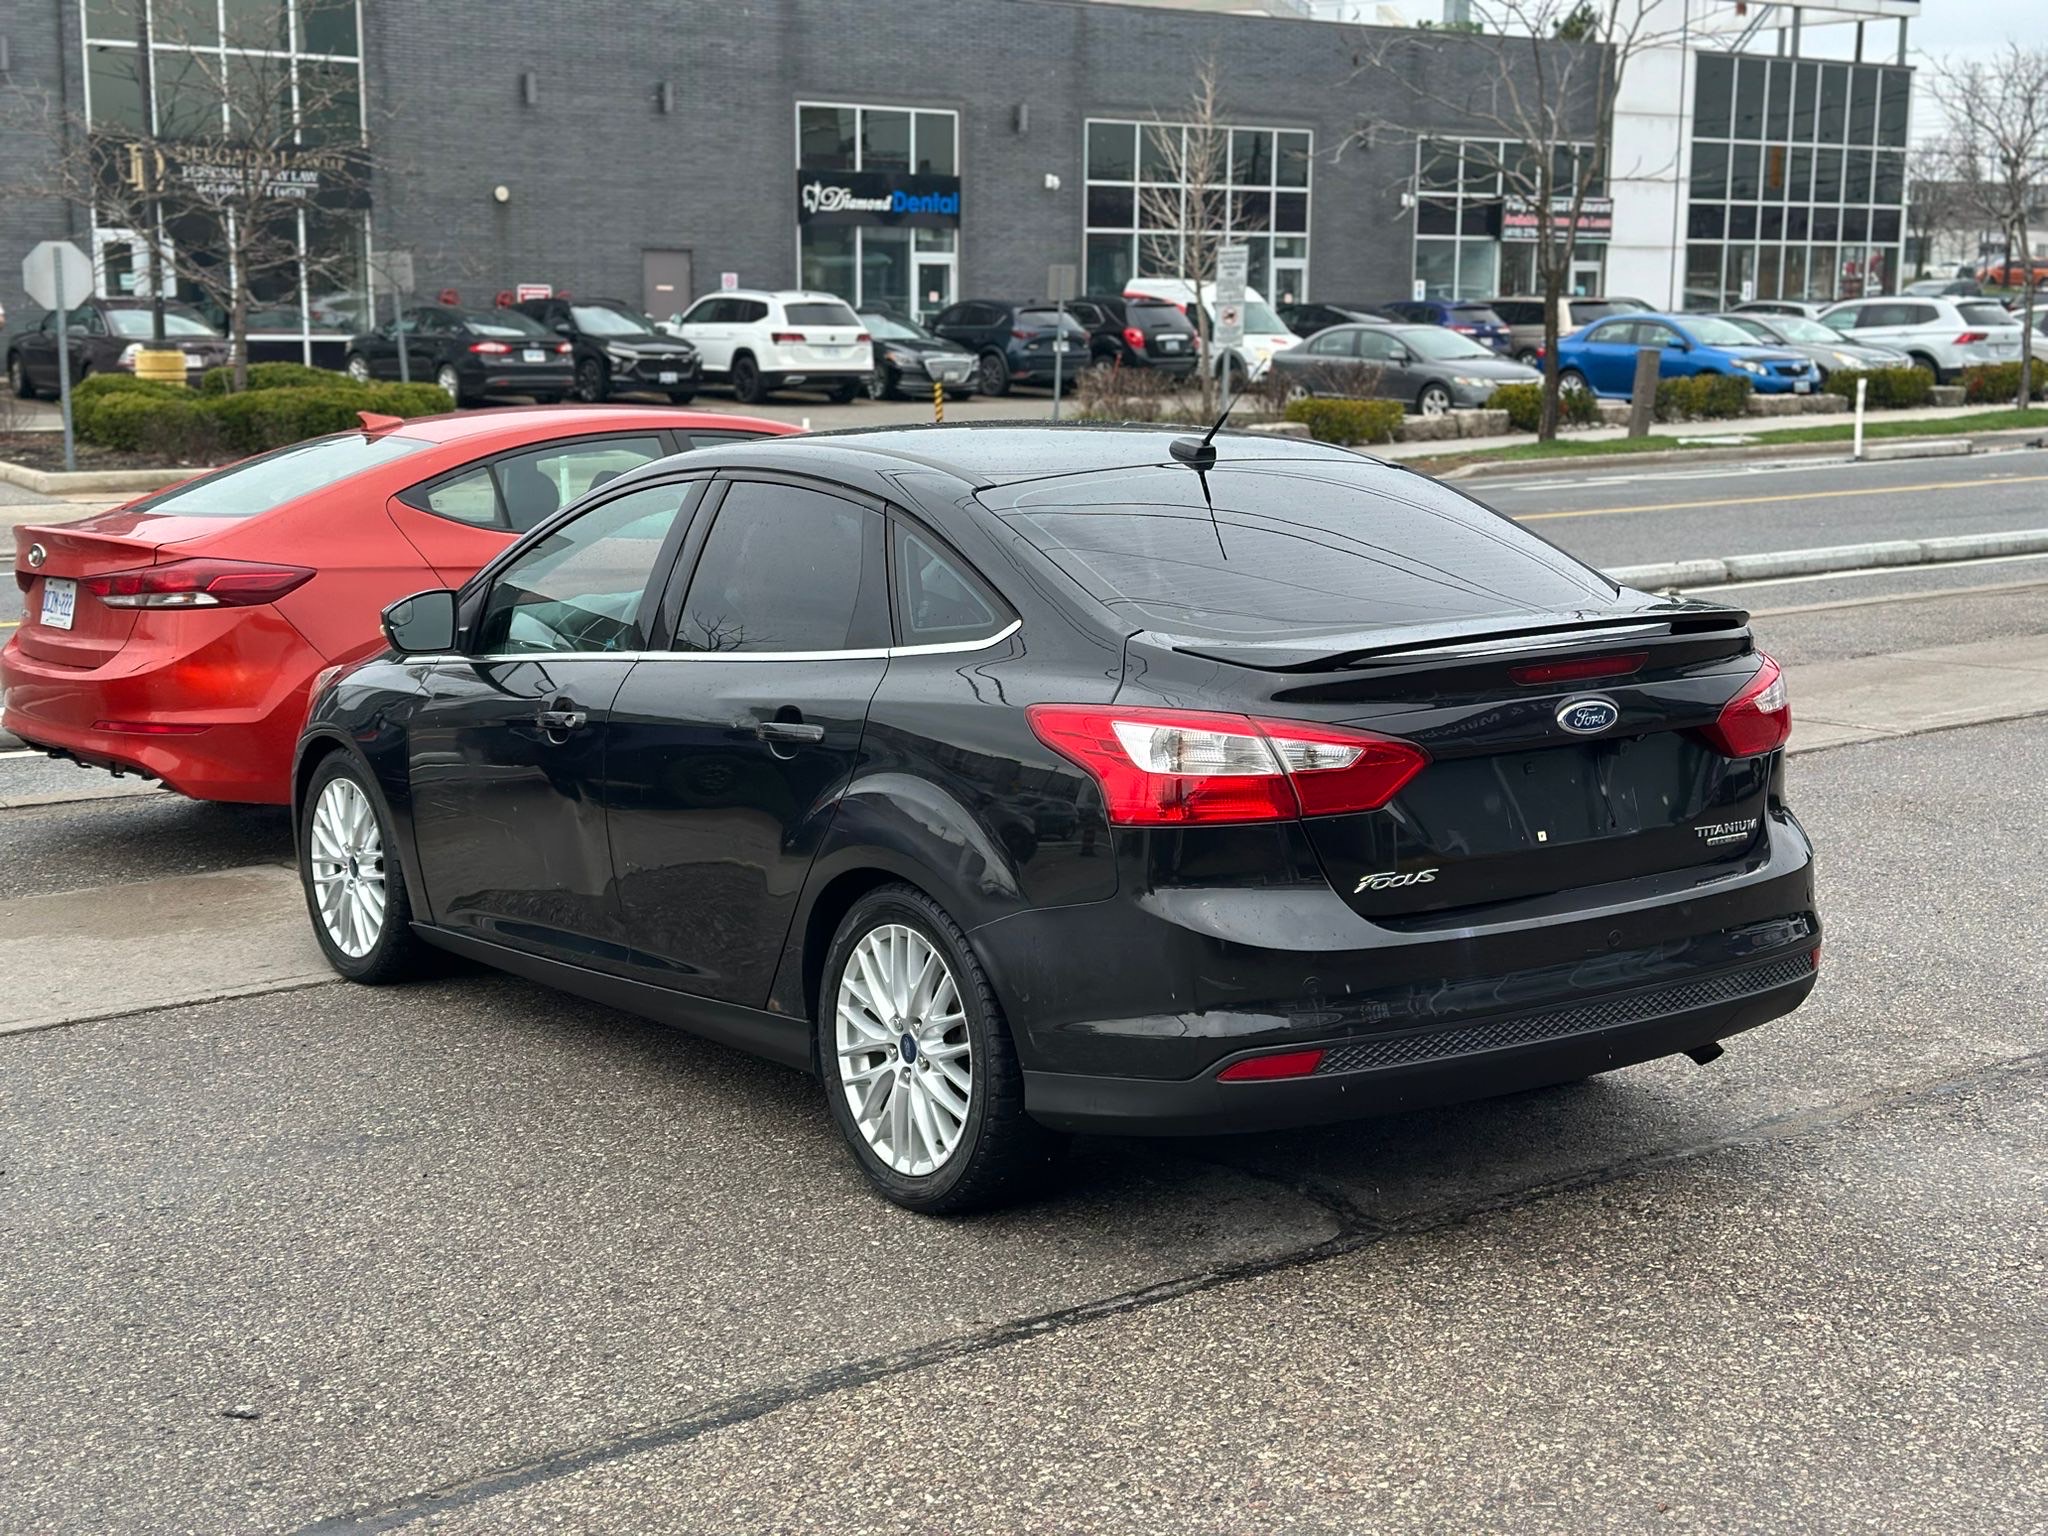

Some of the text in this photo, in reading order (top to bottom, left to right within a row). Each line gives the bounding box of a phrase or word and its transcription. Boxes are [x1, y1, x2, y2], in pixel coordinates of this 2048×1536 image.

[819, 186, 959, 213] Diamond Dental
[1574, 707, 1606, 727] Ford
